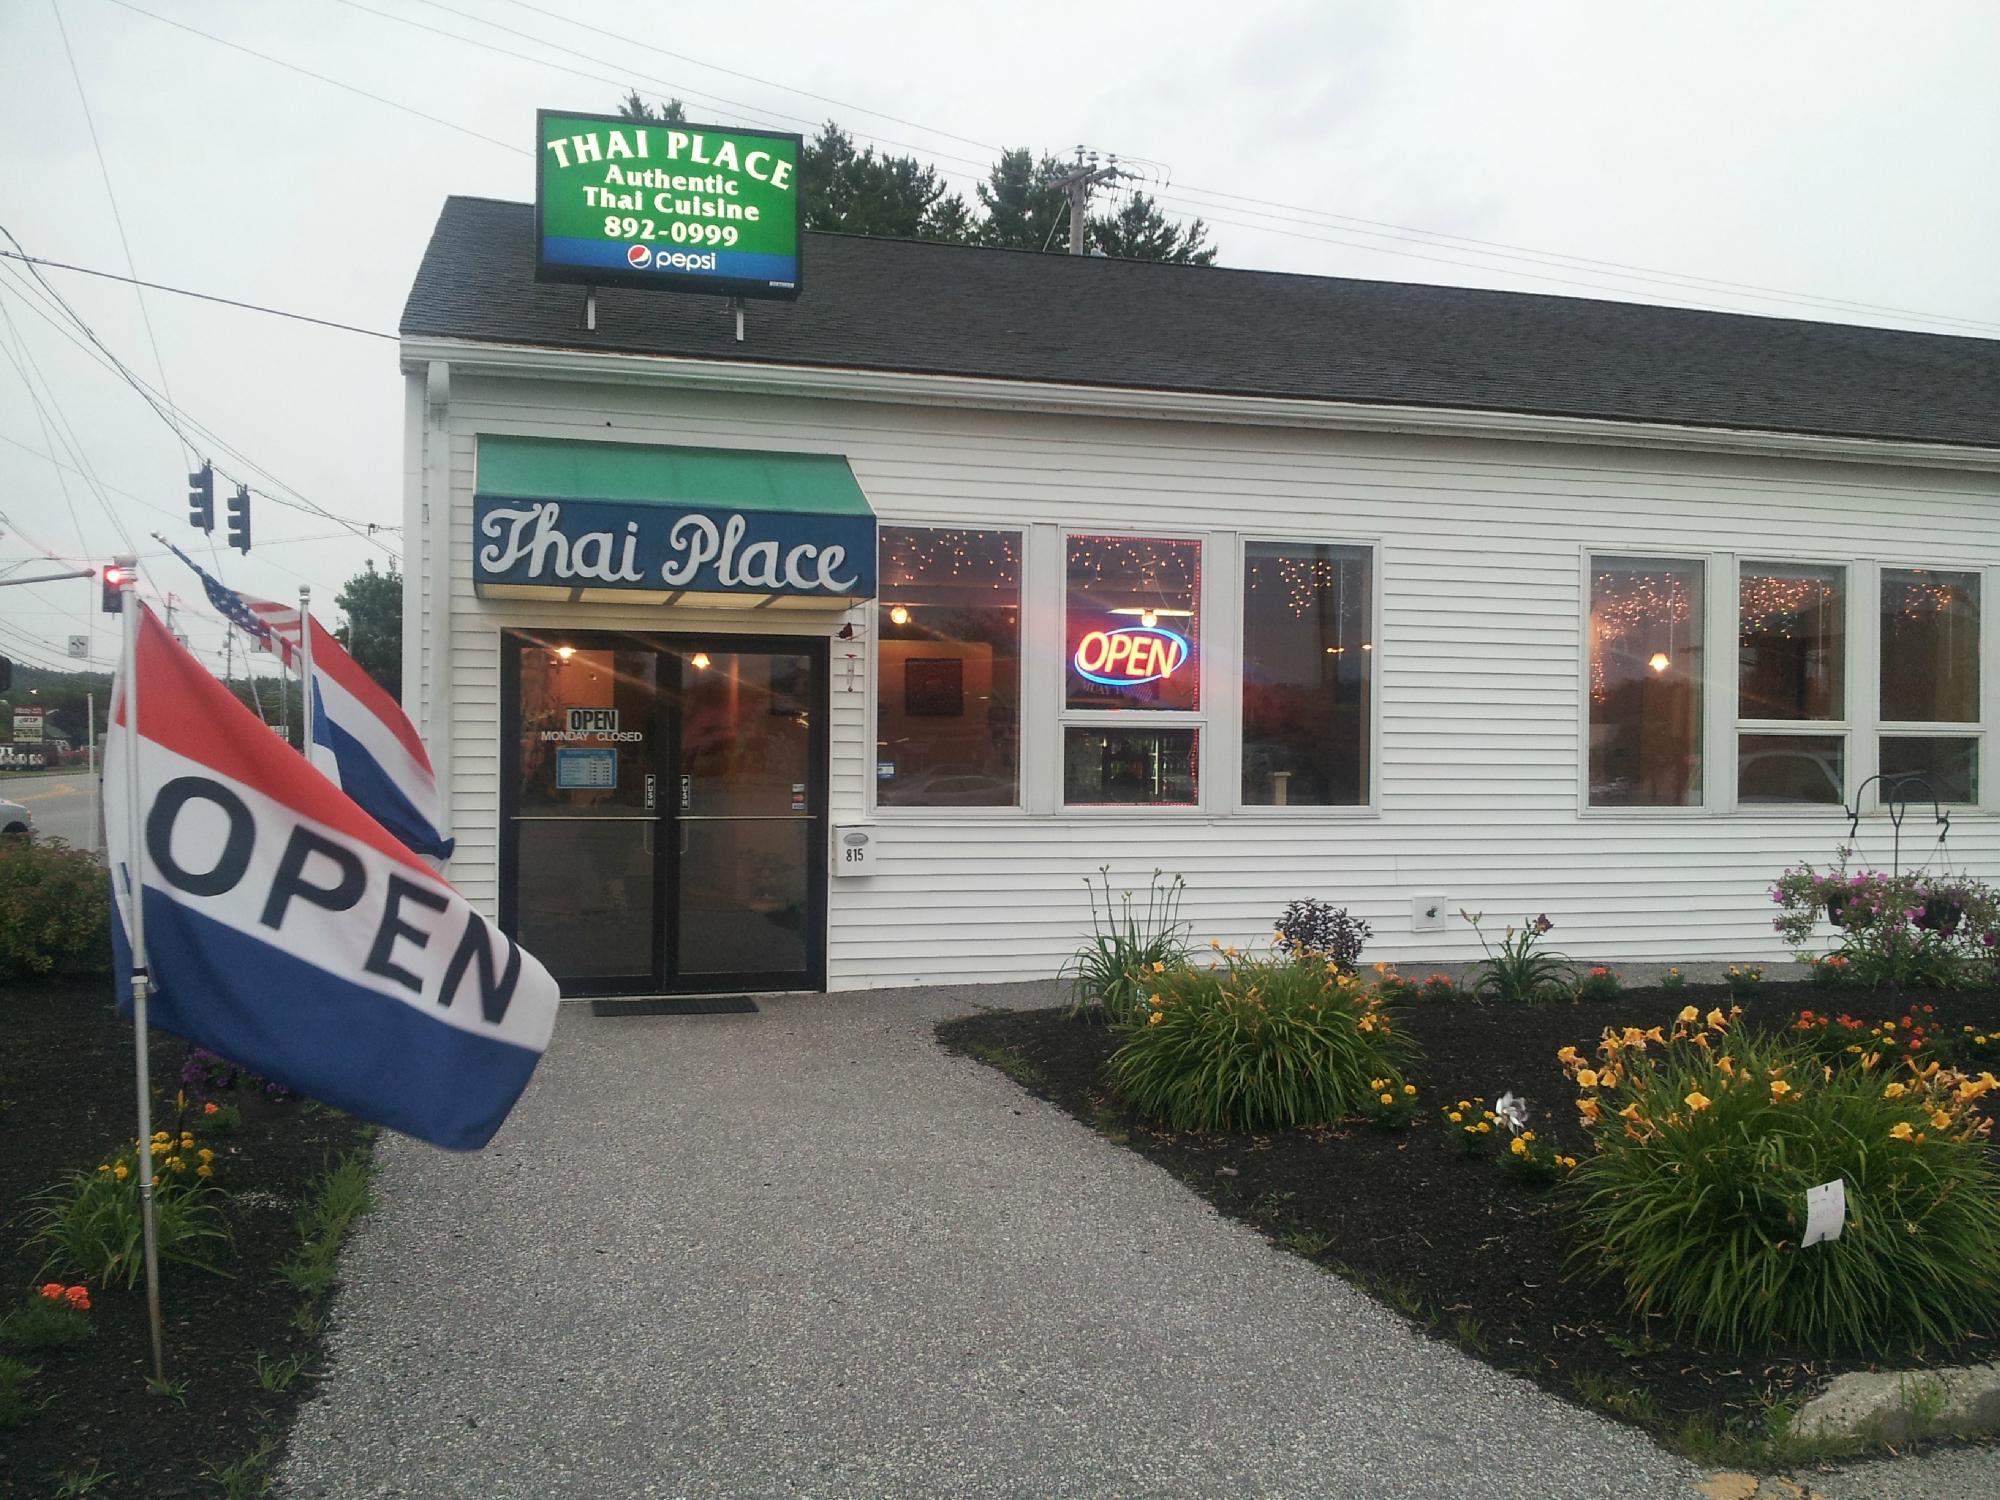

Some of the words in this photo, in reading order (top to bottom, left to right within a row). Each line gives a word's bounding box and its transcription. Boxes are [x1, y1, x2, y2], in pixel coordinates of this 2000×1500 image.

[547, 129, 650, 169] THAI
[666, 130, 793, 190] PLACE
[604, 164, 739, 196] Authentic
[582, 185, 643, 211] Thai
[654, 192, 760, 221] Cuisine
[603, 215, 739, 247] 892-0999
[656, 251, 716, 272] pepsi
[480, 502, 645, 582] Thai
[661, 513, 858, 592] Place
[1078, 631, 1178, 679] OPEN
[571, 710, 616, 730] OPEN
[541, 731, 589, 741] MONDAY
[597, 731, 643, 742] CLOSED
[846, 848, 864, 862] 815
[146, 775, 522, 1026] OPEN
